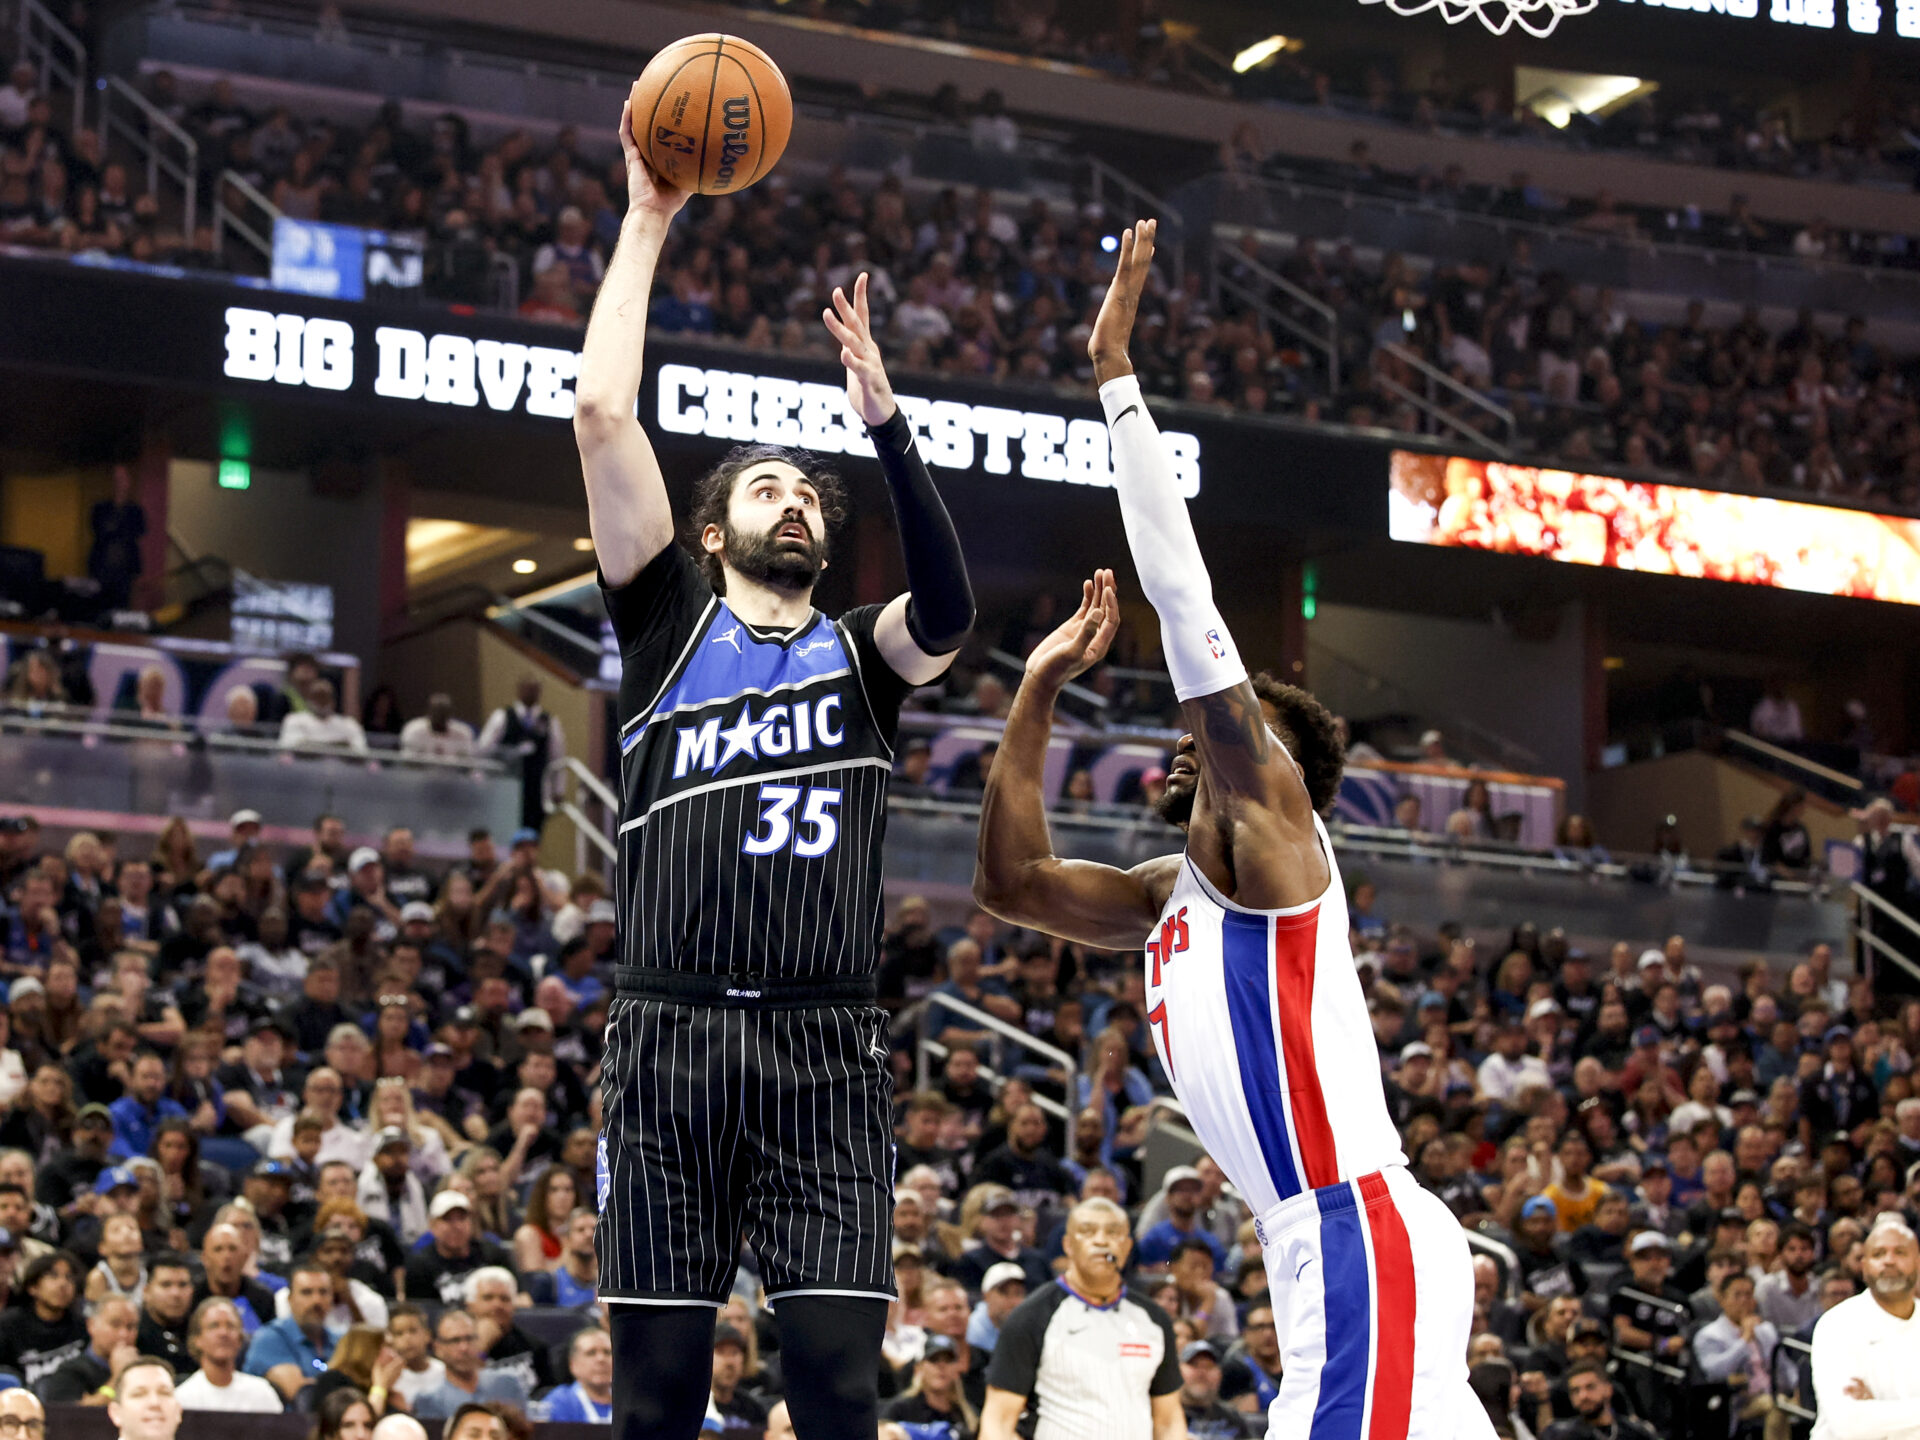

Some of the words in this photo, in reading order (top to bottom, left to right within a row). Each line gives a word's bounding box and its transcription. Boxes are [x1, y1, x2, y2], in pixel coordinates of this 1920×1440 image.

[712, 94, 750, 189] Wilson
[224, 307, 354, 391] BIG
[375, 326, 638, 420] DAVE
[658, 363, 1200, 499] CHEEESTEAS
[672, 694, 845, 779] MAGIC
[742, 784, 843, 858] 35
[726, 988, 761, 998] ORLANDO
